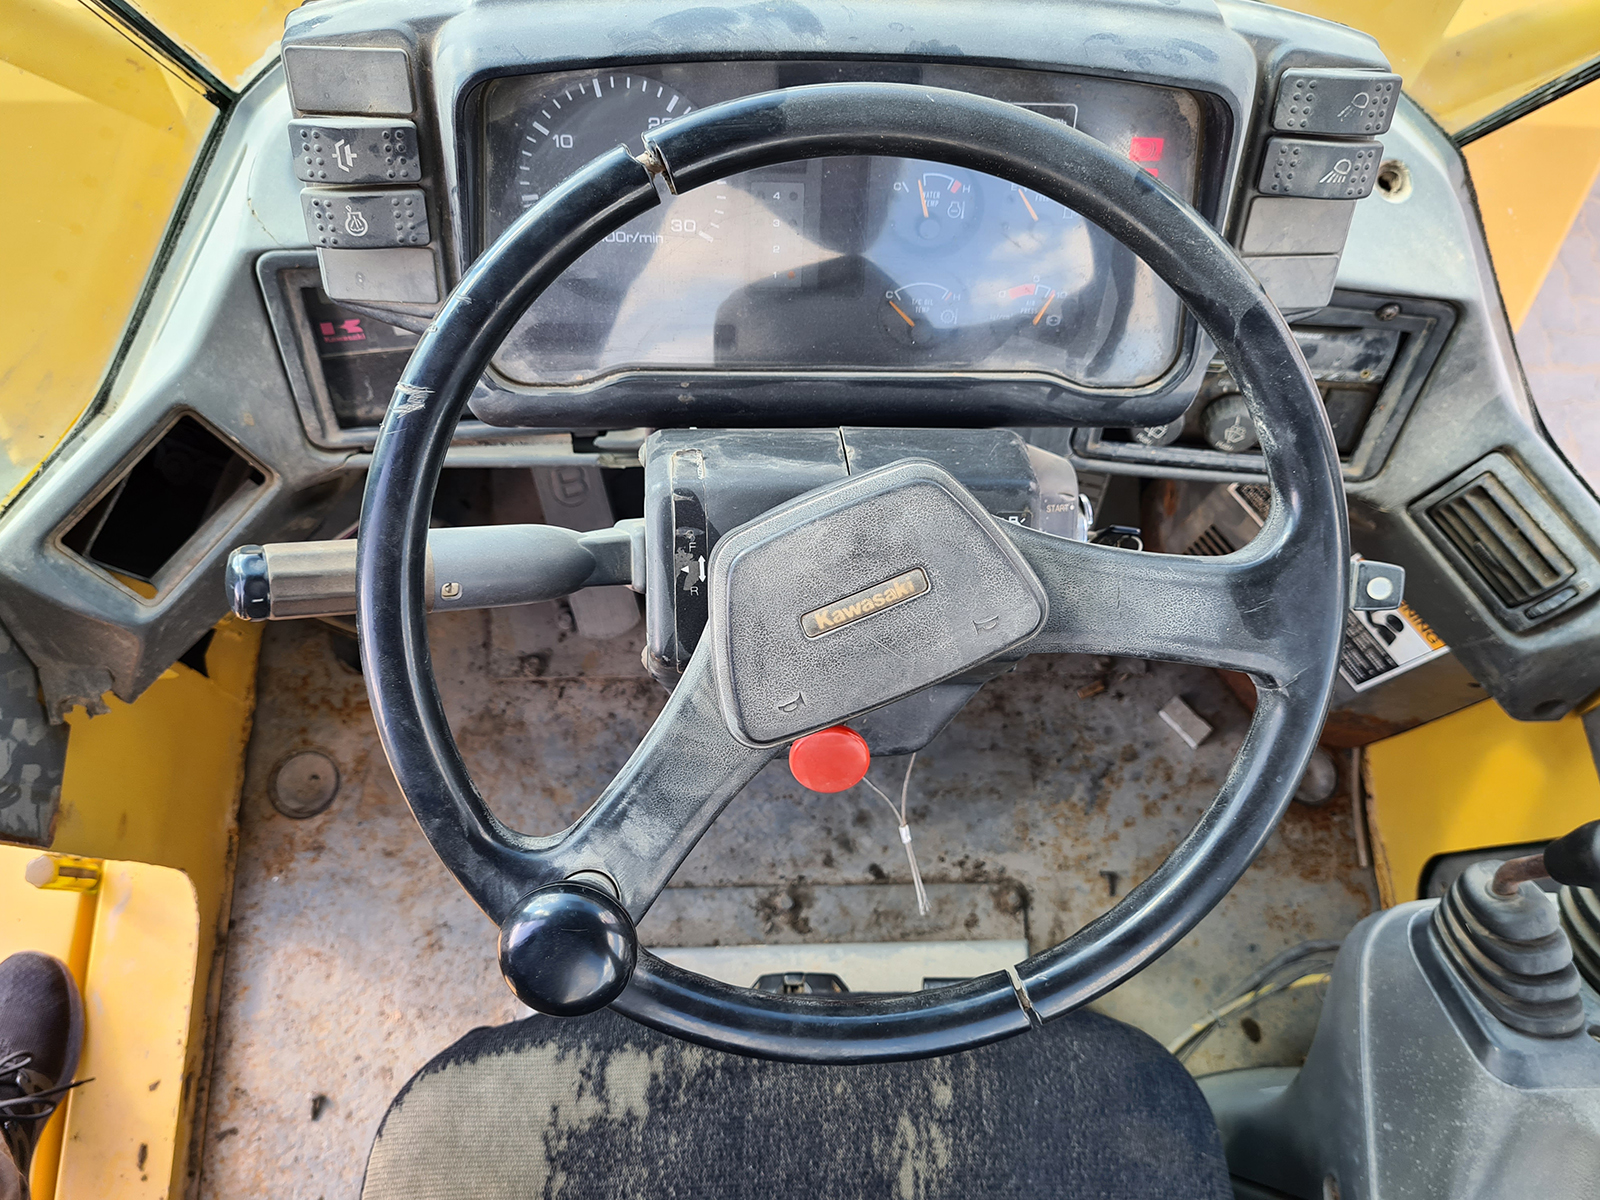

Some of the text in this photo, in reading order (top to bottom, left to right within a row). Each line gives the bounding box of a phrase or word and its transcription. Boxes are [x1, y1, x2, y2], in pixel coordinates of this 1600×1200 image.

[552, 134, 573, 148] 10
[893, 182, 902, 191] C
[962, 184, 971, 193] H
[773, 191, 780, 200] 4
[670, 219, 696, 232] 30
[772, 218, 780, 228] 3
[602, 231, 664, 244] 00r/min
[772, 245, 780, 254] 2
[885, 290, 893, 299] C
[953, 293, 961, 302] H
[1045, 504, 1069, 513] START
[688, 541, 697, 553] F
[690, 586, 699, 596] R
[814, 576, 915, 630] Kawasaki
